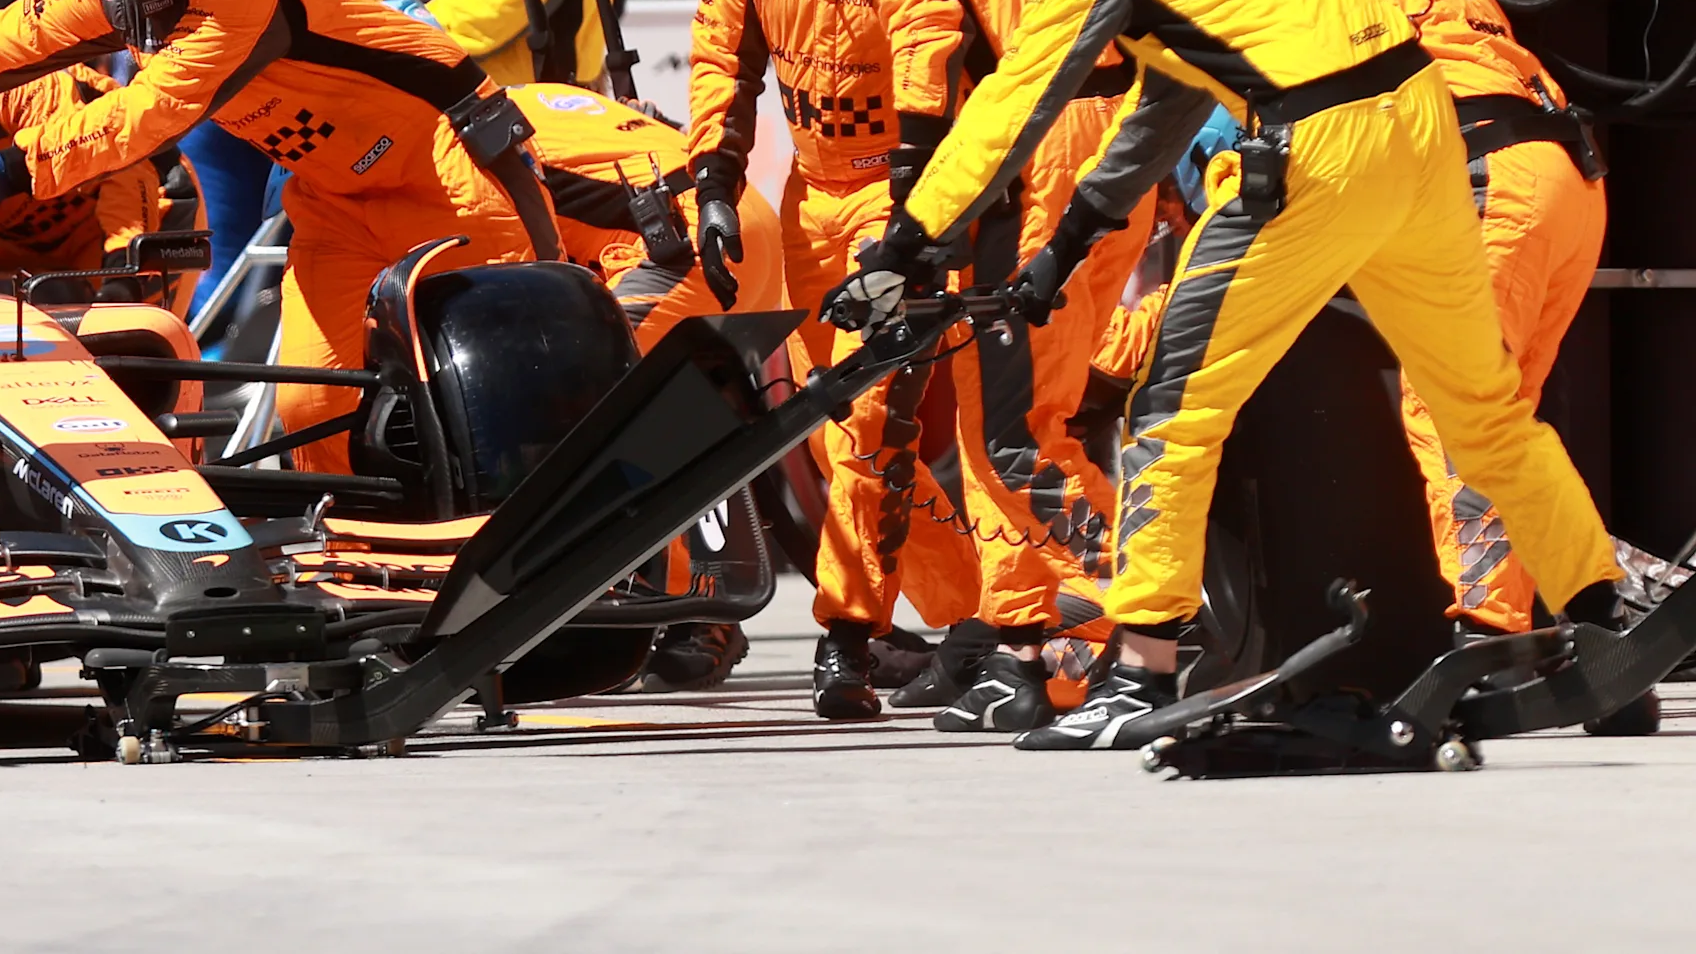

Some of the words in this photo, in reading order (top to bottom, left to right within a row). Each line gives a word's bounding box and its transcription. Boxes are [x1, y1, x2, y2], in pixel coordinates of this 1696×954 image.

[798, 52, 881, 77] Technologies
[79, 124, 112, 146] MILLE
[354, 137, 393, 174] sparco
[160, 247, 204, 259] Medallia
[0, 379, 95, 390] alteryx
[22, 396, 105, 405] DELL
[56, 420, 124, 431] Gulf
[78, 449, 161, 458] DataRobot
[96, 464, 179, 477] OKX
[12, 457, 74, 520] McLaren
[172, 522, 222, 543] K
